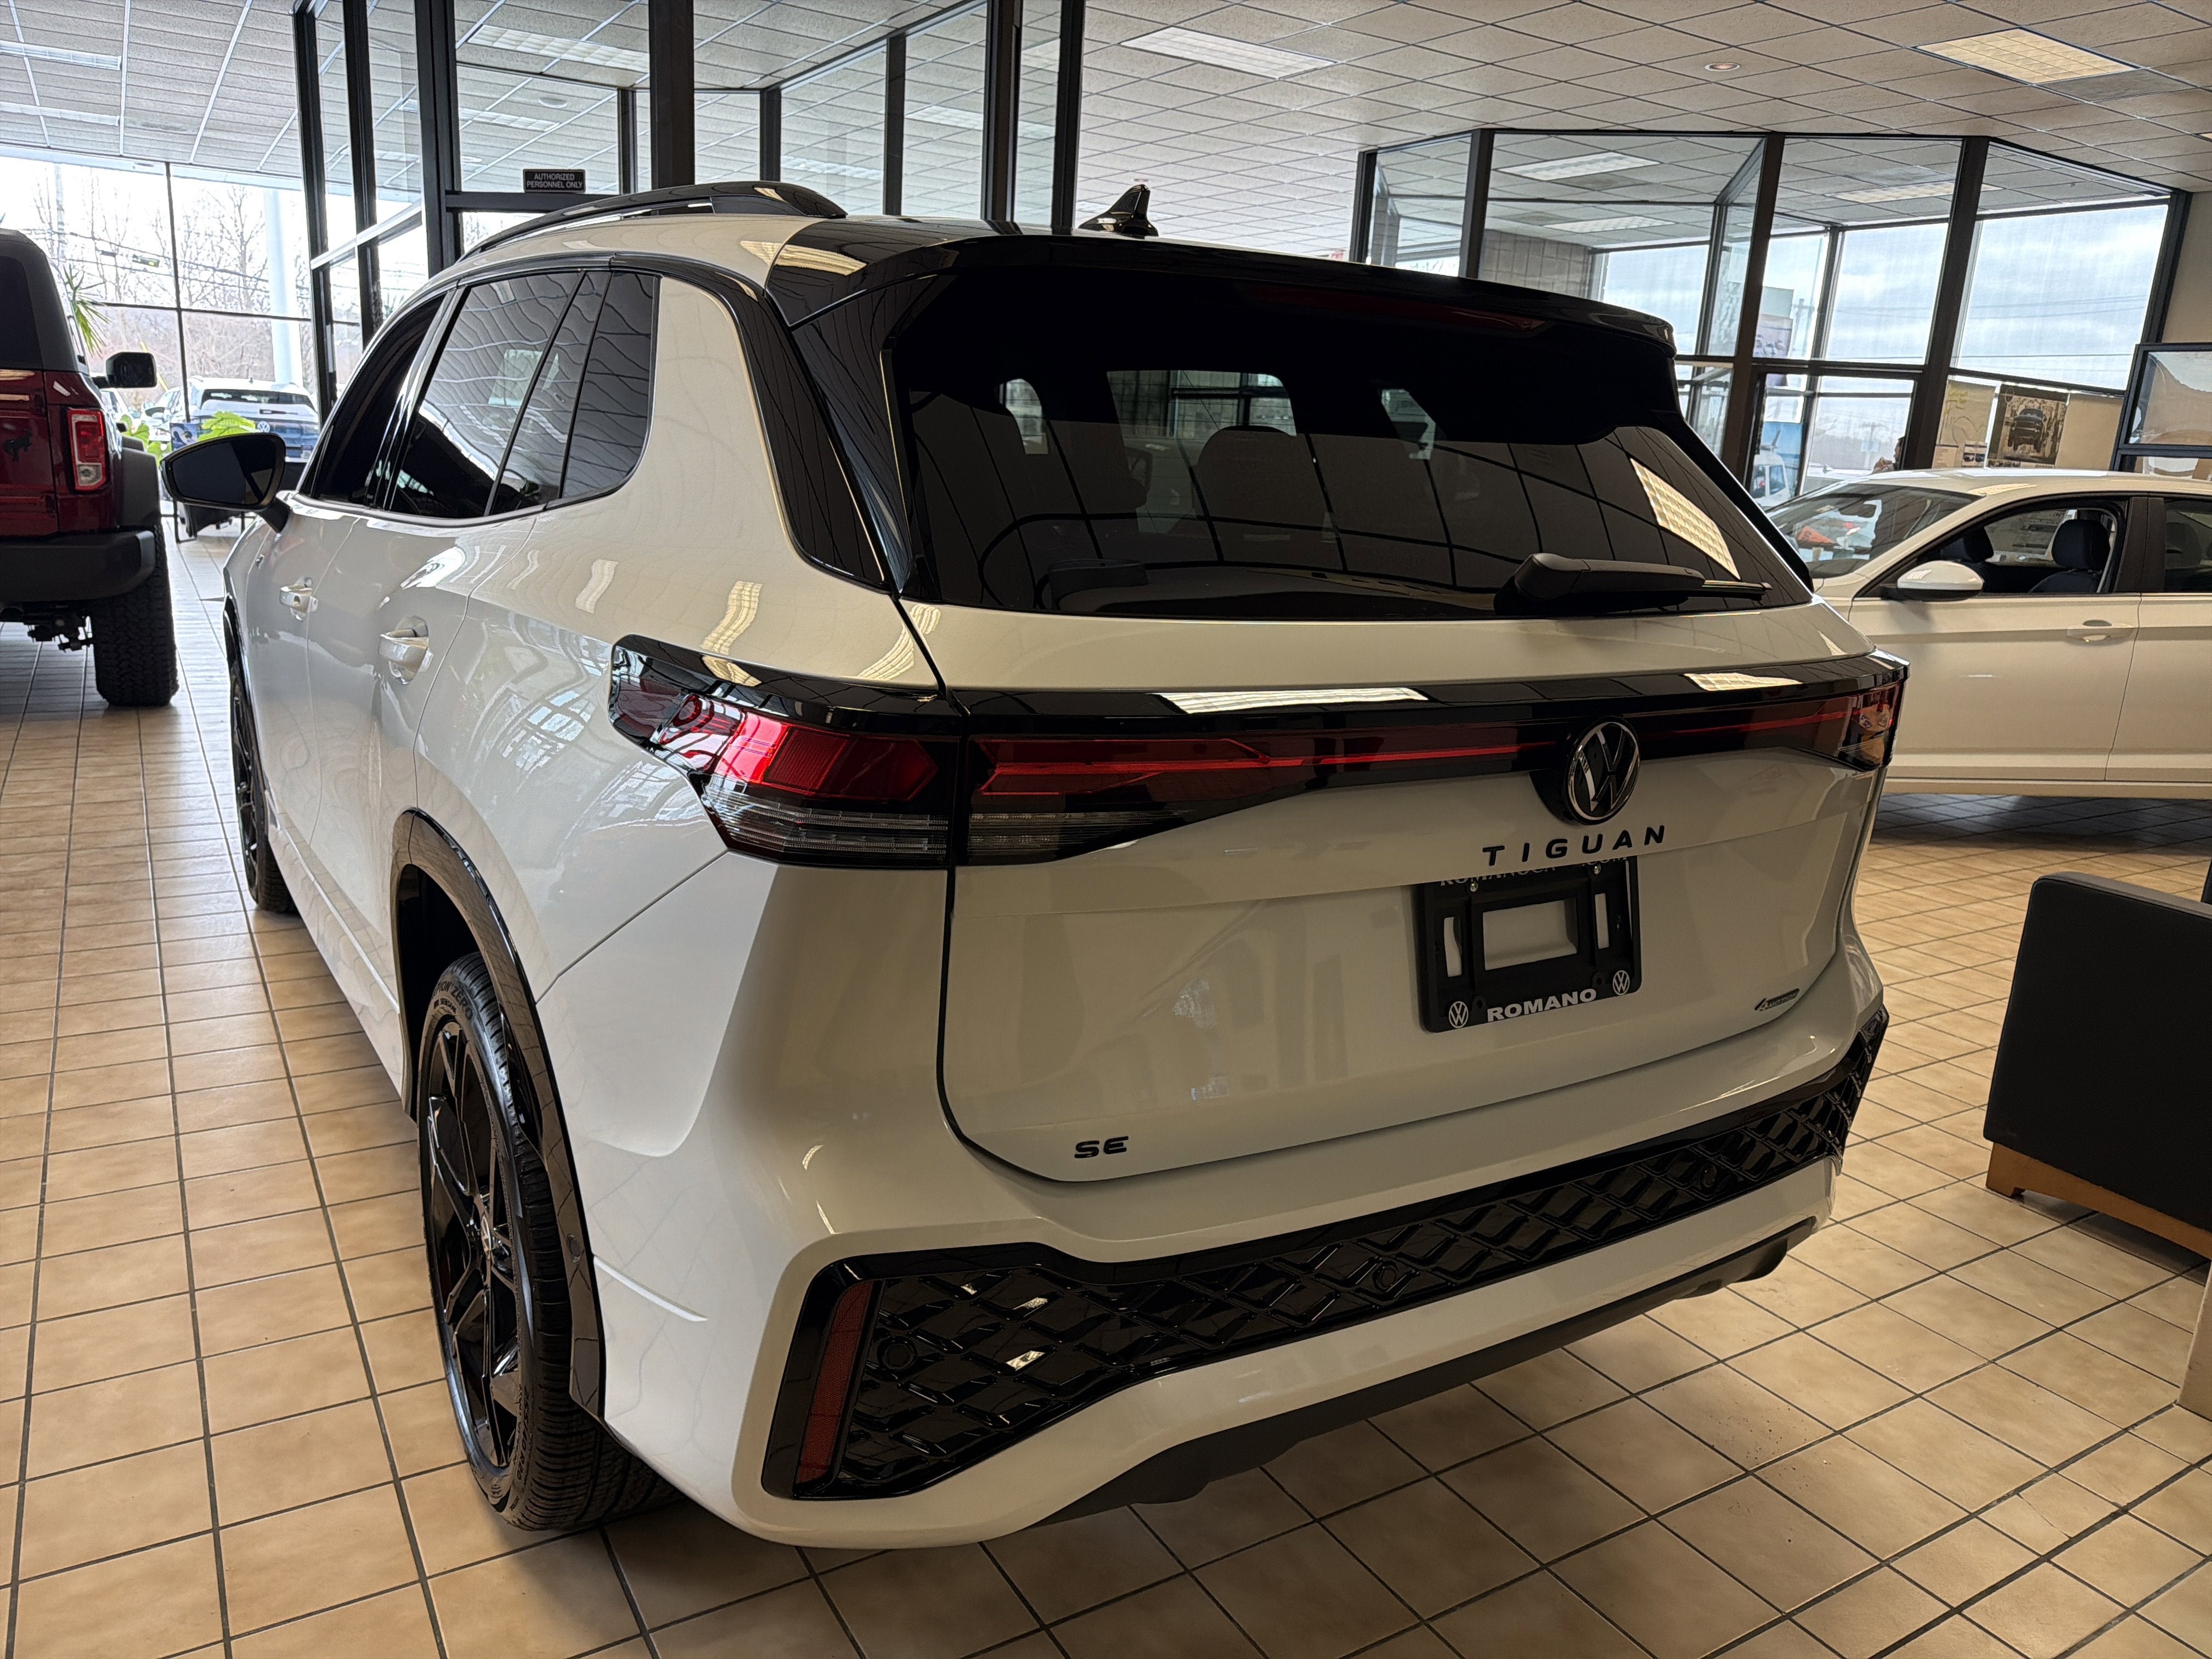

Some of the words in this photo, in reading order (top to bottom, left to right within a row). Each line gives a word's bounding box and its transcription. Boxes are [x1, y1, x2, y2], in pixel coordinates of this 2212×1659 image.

[527, 180, 565, 188] PERSONNEL
[534, 172, 575, 180] AUTHORIZED
[1482, 825, 1665, 866] TIGUAN
[1487, 988, 1597, 1023] ROMANO
[1074, 1136, 1129, 1159] SE
